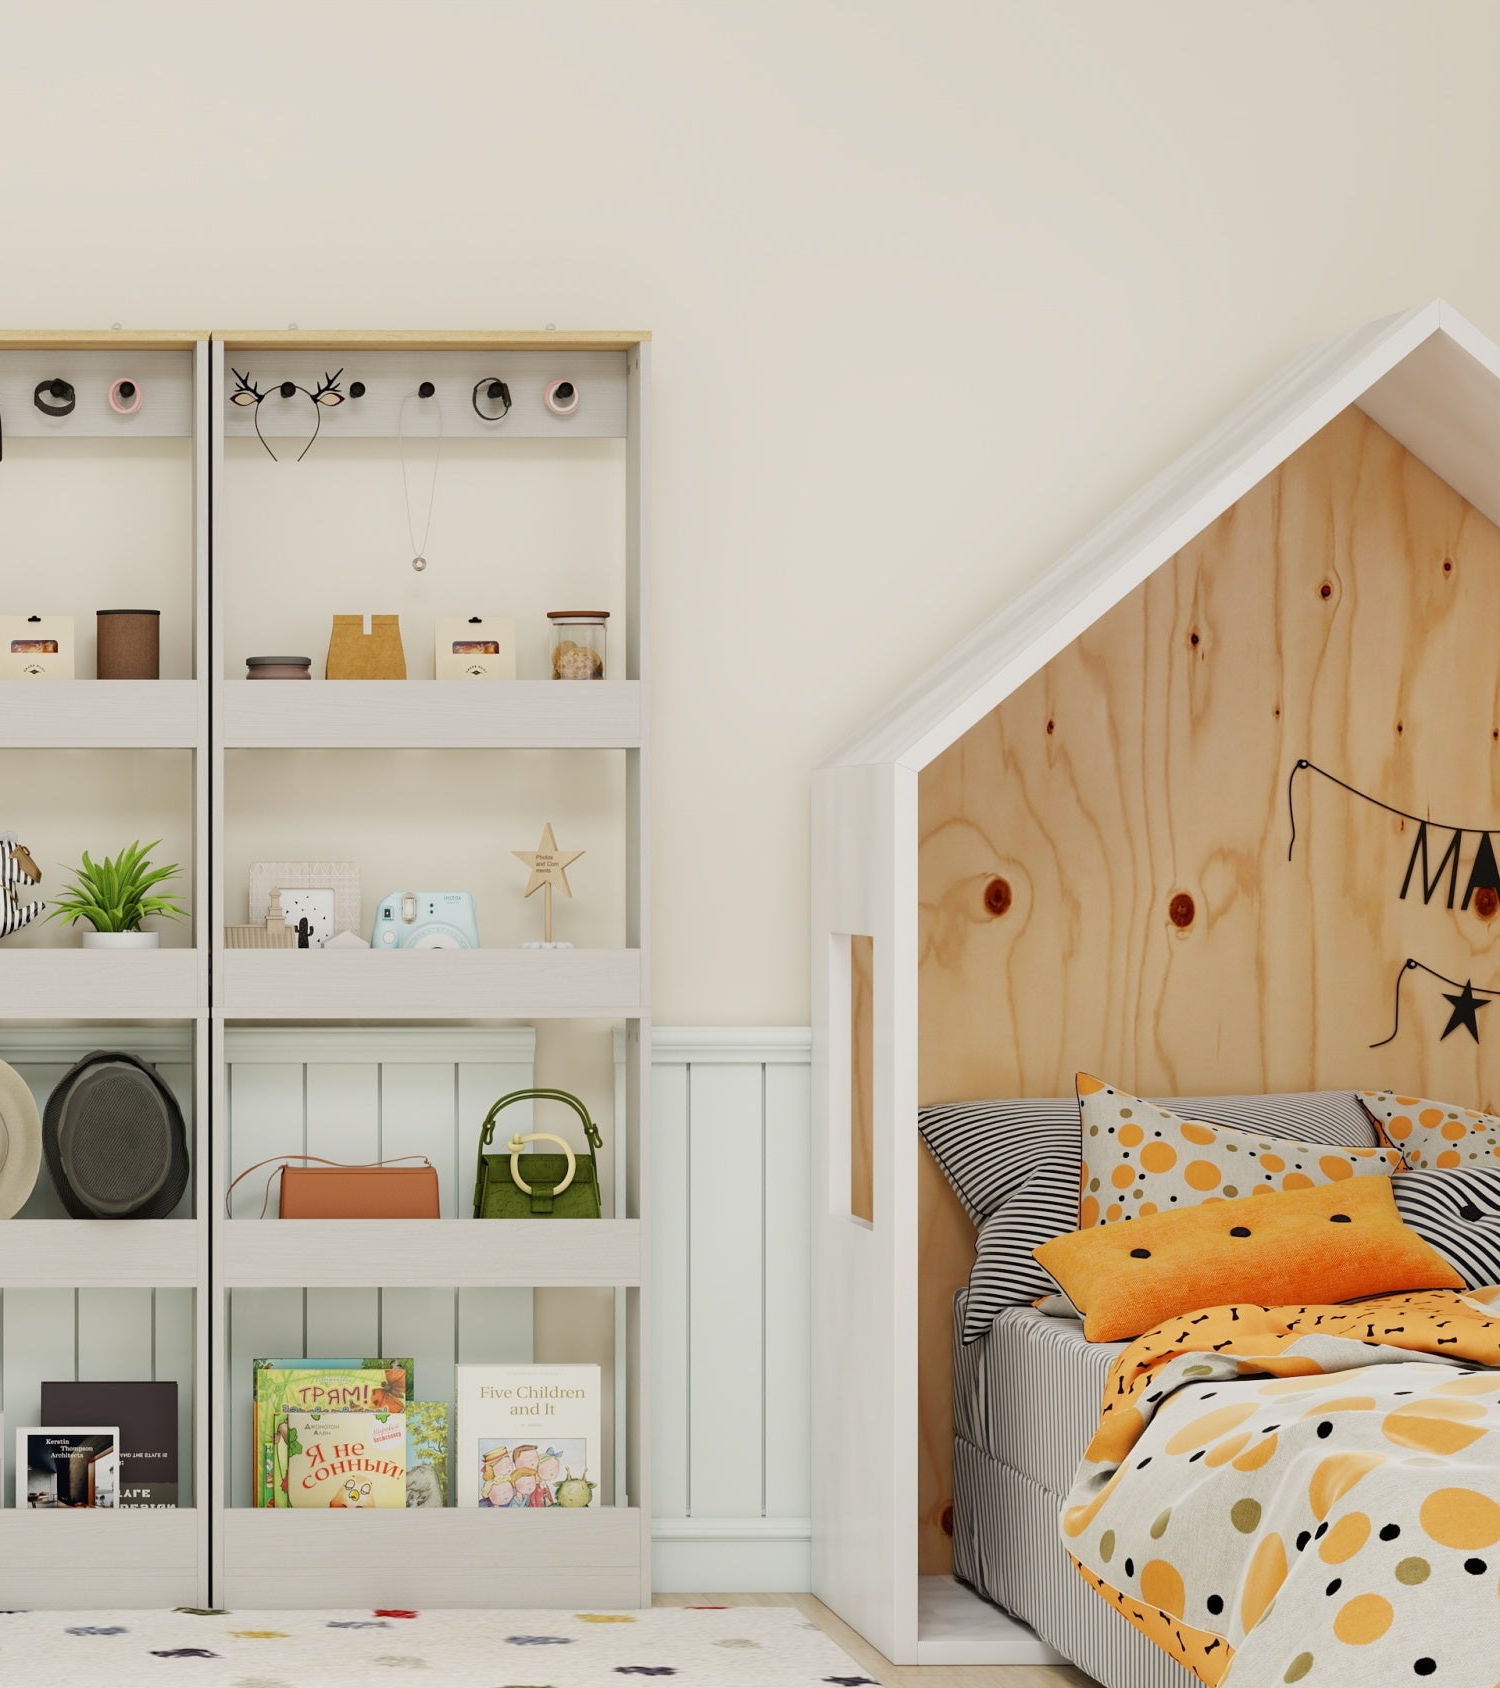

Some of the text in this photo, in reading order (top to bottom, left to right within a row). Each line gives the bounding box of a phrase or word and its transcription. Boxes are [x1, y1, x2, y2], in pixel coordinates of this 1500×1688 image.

[298, 1384, 368, 1405] ТРЯМ!
[479, 1386, 585, 1399] Five Children
[509, 1402, 556, 1415] and It
[305, 1442, 365, 1468] Я не
[301, 1459, 405, 1489] сонный!
